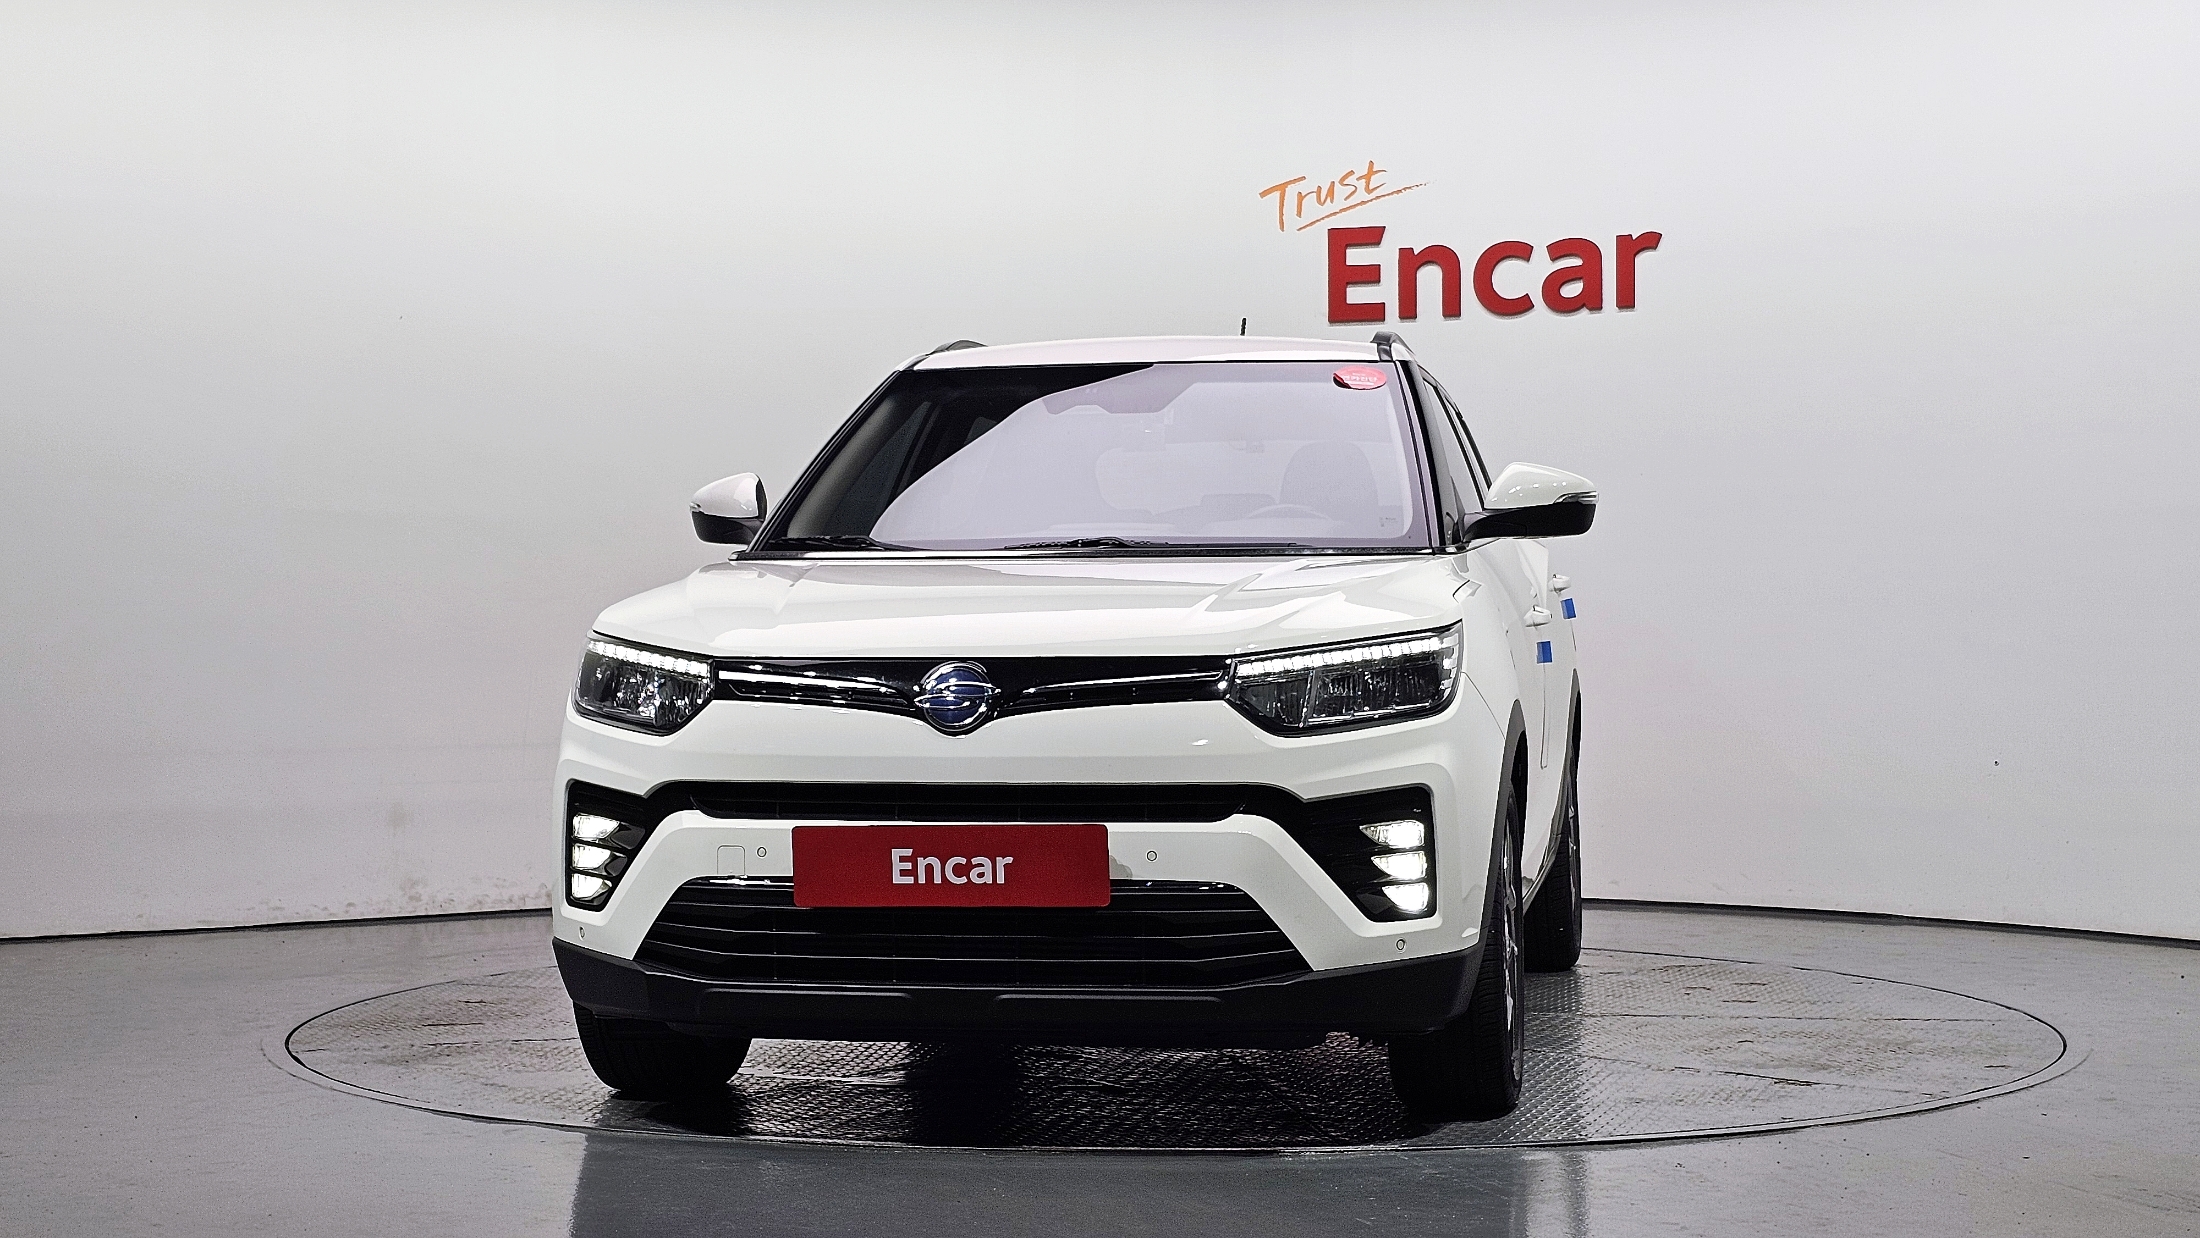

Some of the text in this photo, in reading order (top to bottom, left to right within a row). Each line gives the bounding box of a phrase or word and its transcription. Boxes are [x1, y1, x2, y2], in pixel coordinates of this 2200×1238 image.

[1259, 160, 1387, 232] Trust
[1327, 226, 1663, 324] Encar
[891, 848, 1014, 884] Encar
